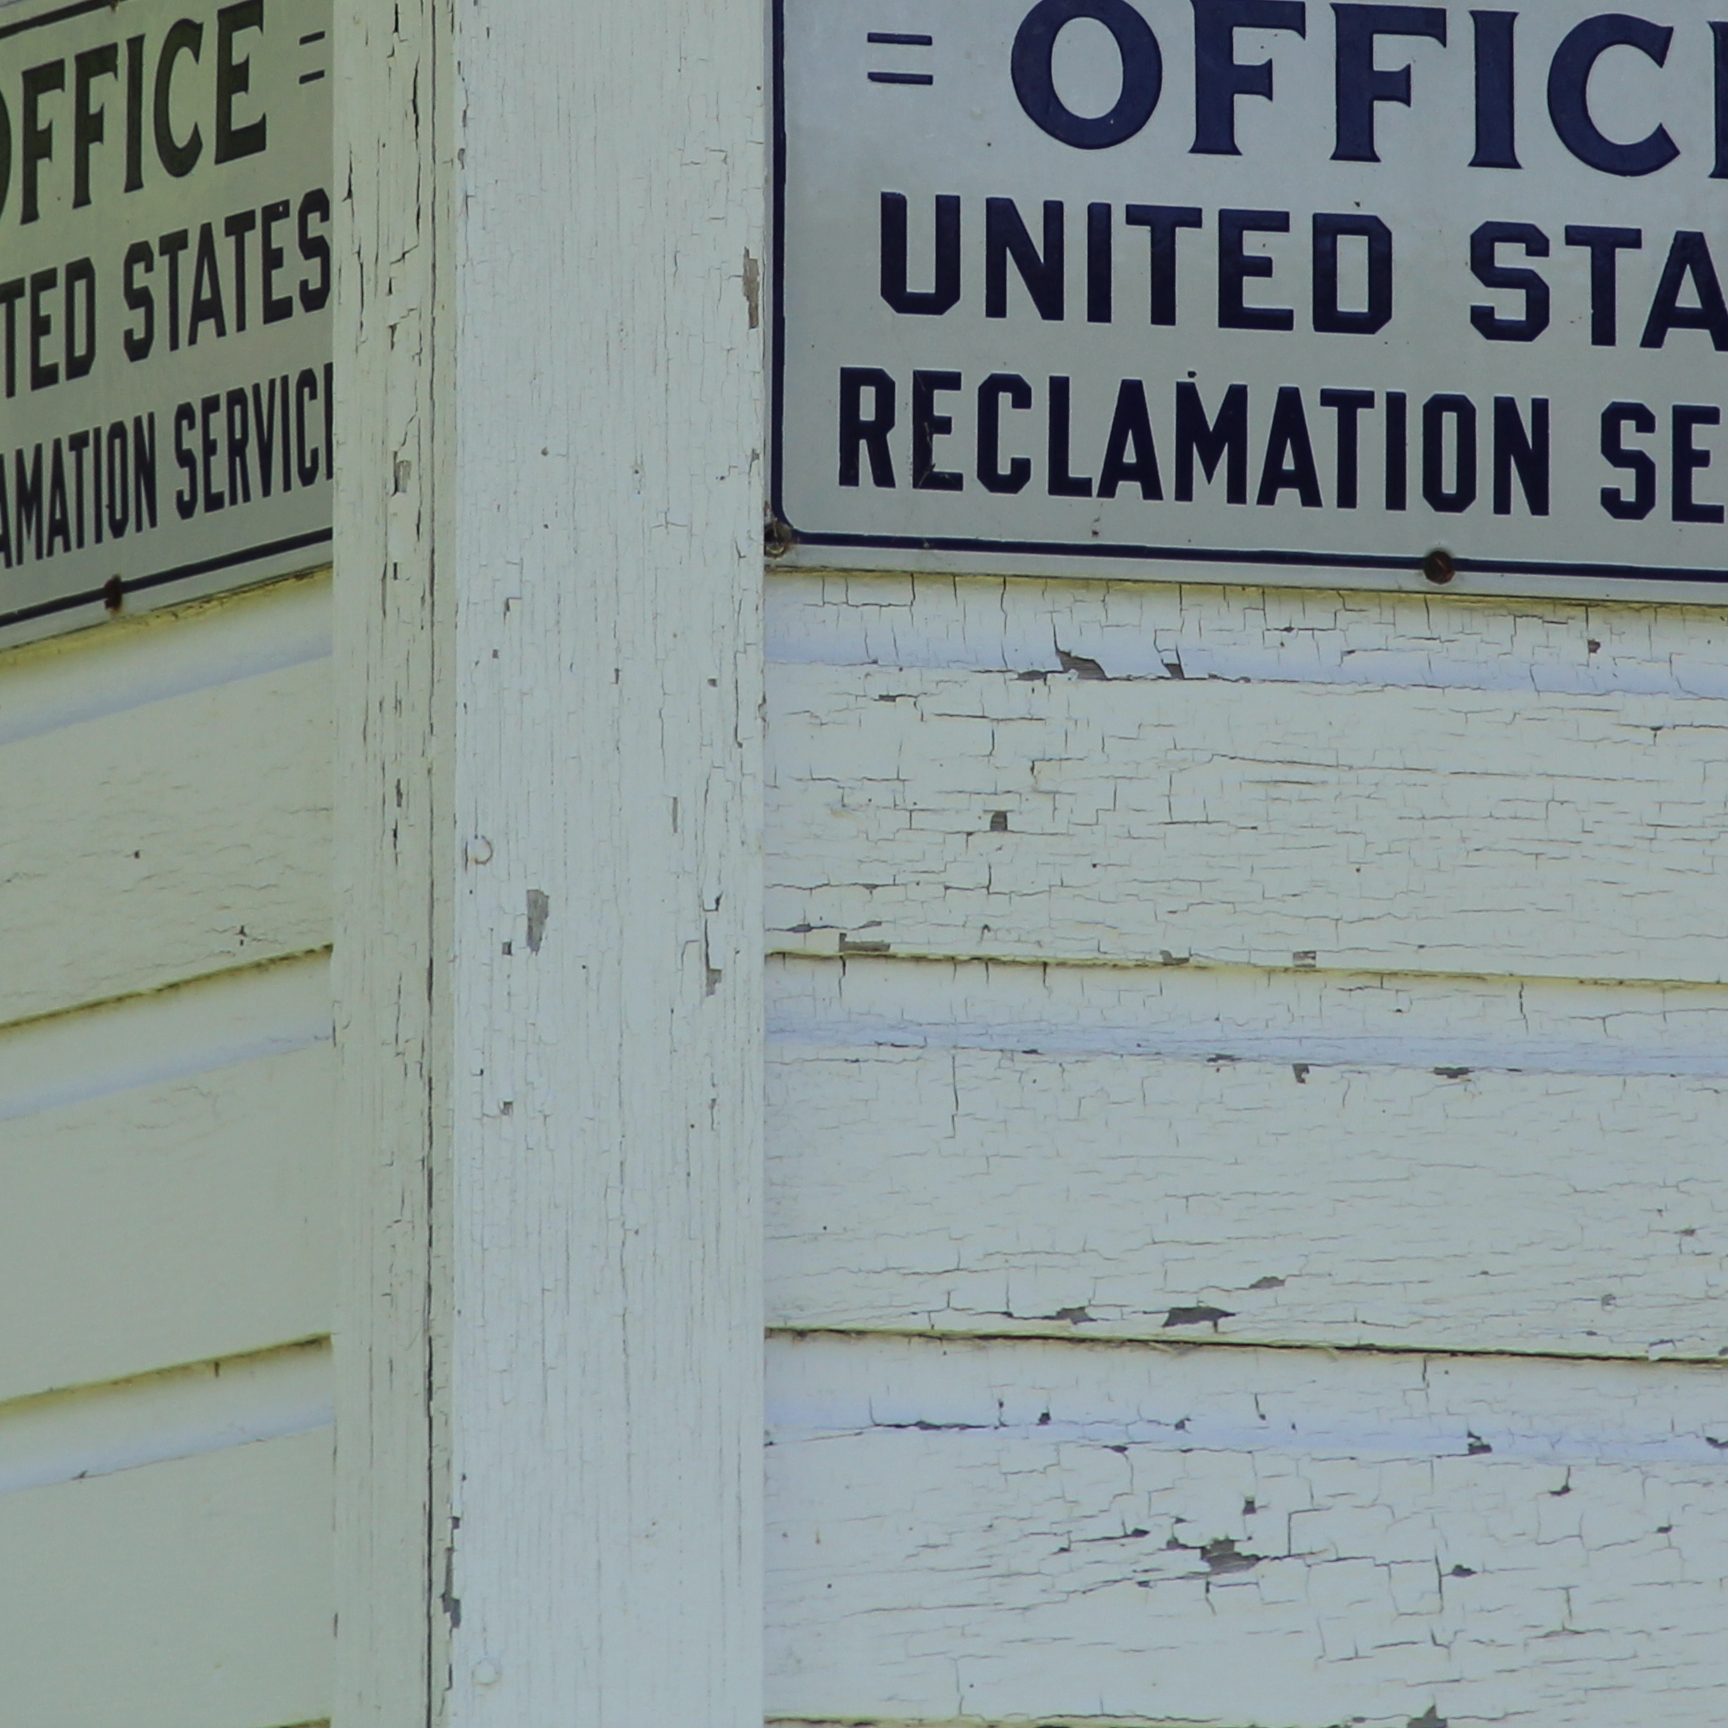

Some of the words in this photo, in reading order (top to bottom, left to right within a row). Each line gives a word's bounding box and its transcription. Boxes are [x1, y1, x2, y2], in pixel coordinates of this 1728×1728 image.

[123, 187, 331, 363] STATES
[879, 191, 1394, 336] UNITED
[838, 366, 1551, 517] RECLAMATION
